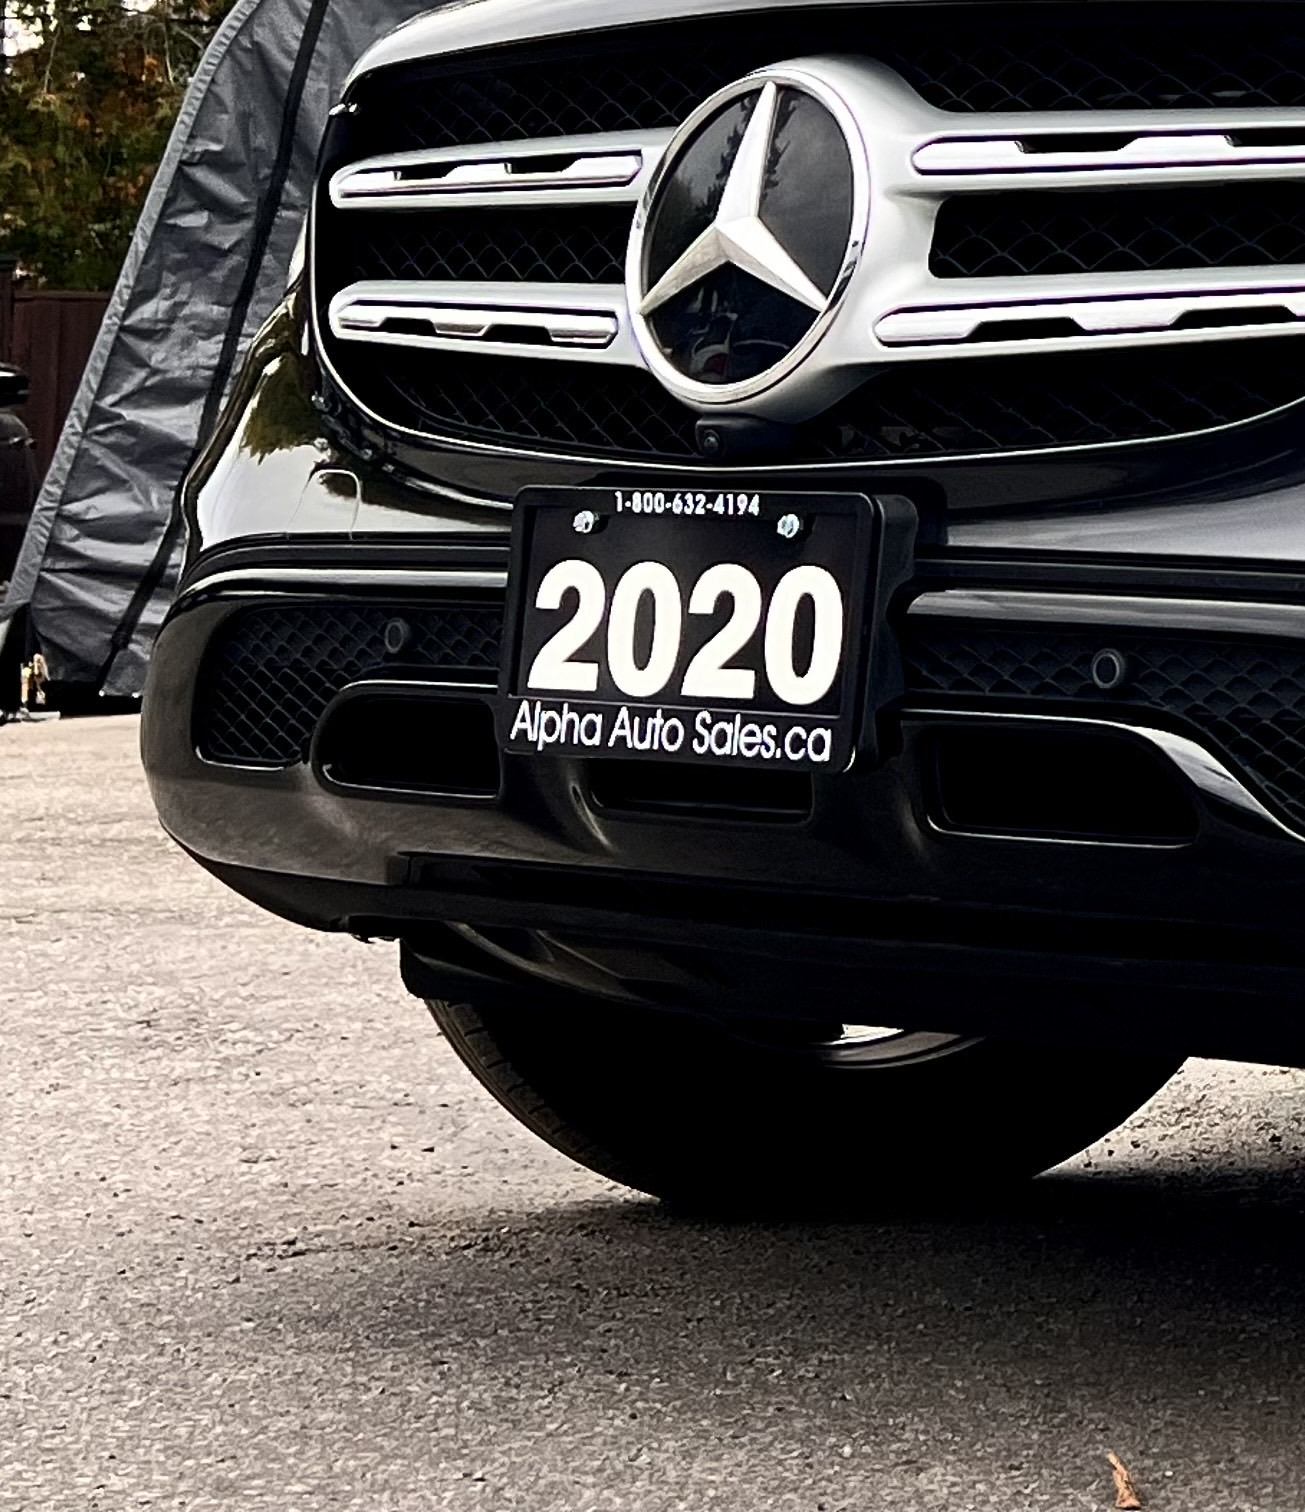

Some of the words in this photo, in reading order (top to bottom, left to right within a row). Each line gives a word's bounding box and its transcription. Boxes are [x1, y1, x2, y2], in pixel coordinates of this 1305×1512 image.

[614, 490, 760, 517] 1-800-632-4194
[527, 559, 843, 705] 2020
[510, 699, 603, 751] Alpha
[608, 706, 685, 753] Auto
[692, 709, 832, 762] Sales.ca
